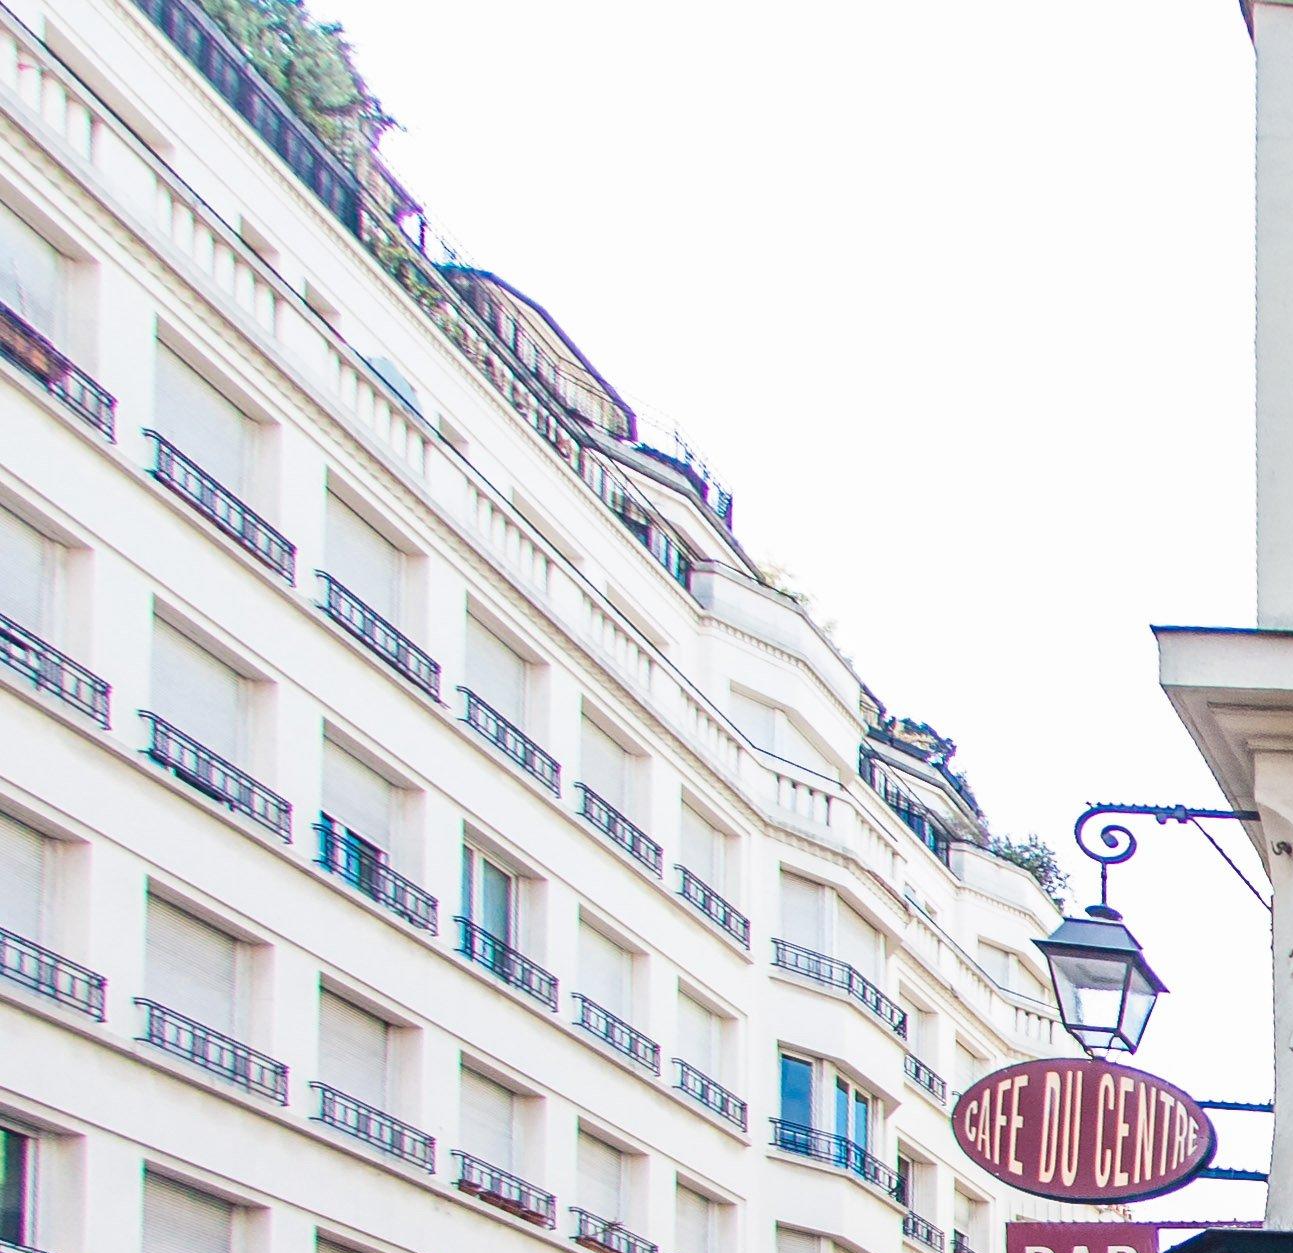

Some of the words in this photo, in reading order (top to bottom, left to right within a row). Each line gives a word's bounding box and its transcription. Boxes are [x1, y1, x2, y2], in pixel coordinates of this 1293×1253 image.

[964, 1074, 1029, 1176] CAFE
[1038, 1071, 1083, 1188] DU
[1094, 1073, 1200, 1188] CENTRE
